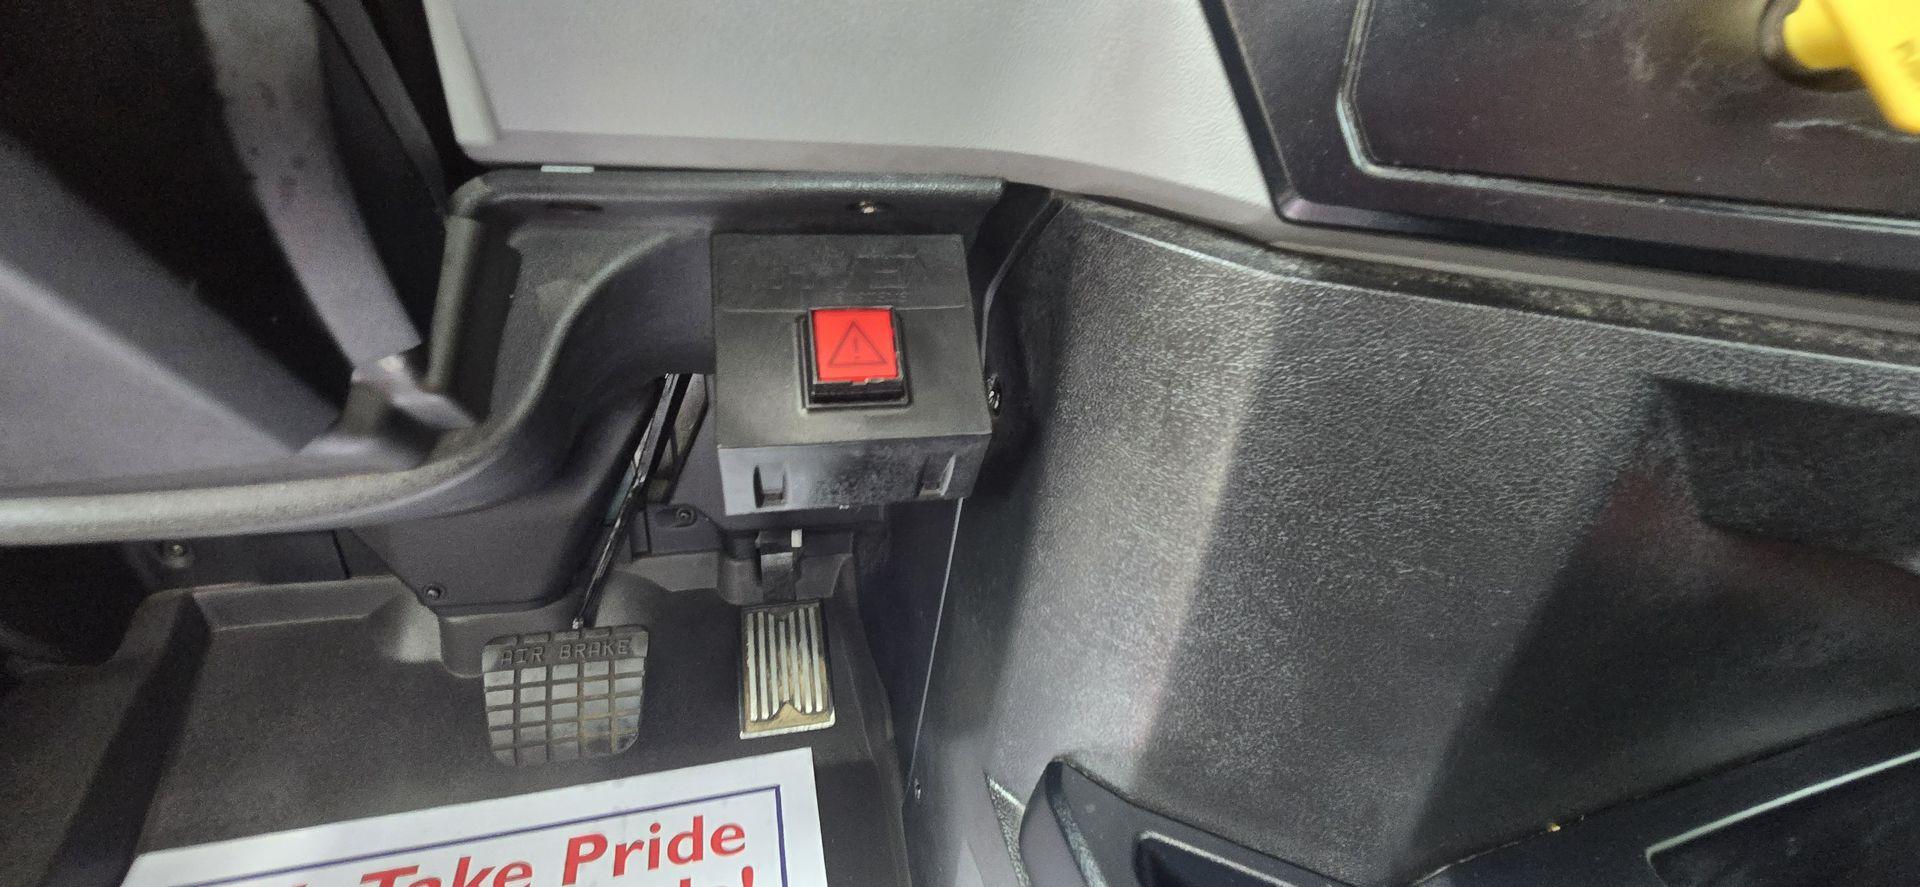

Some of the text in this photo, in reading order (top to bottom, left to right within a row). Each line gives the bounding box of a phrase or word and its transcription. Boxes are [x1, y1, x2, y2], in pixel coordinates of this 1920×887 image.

[500, 639, 630, 666] AIR BRAKE
[561, 814, 746, 886] Pride
